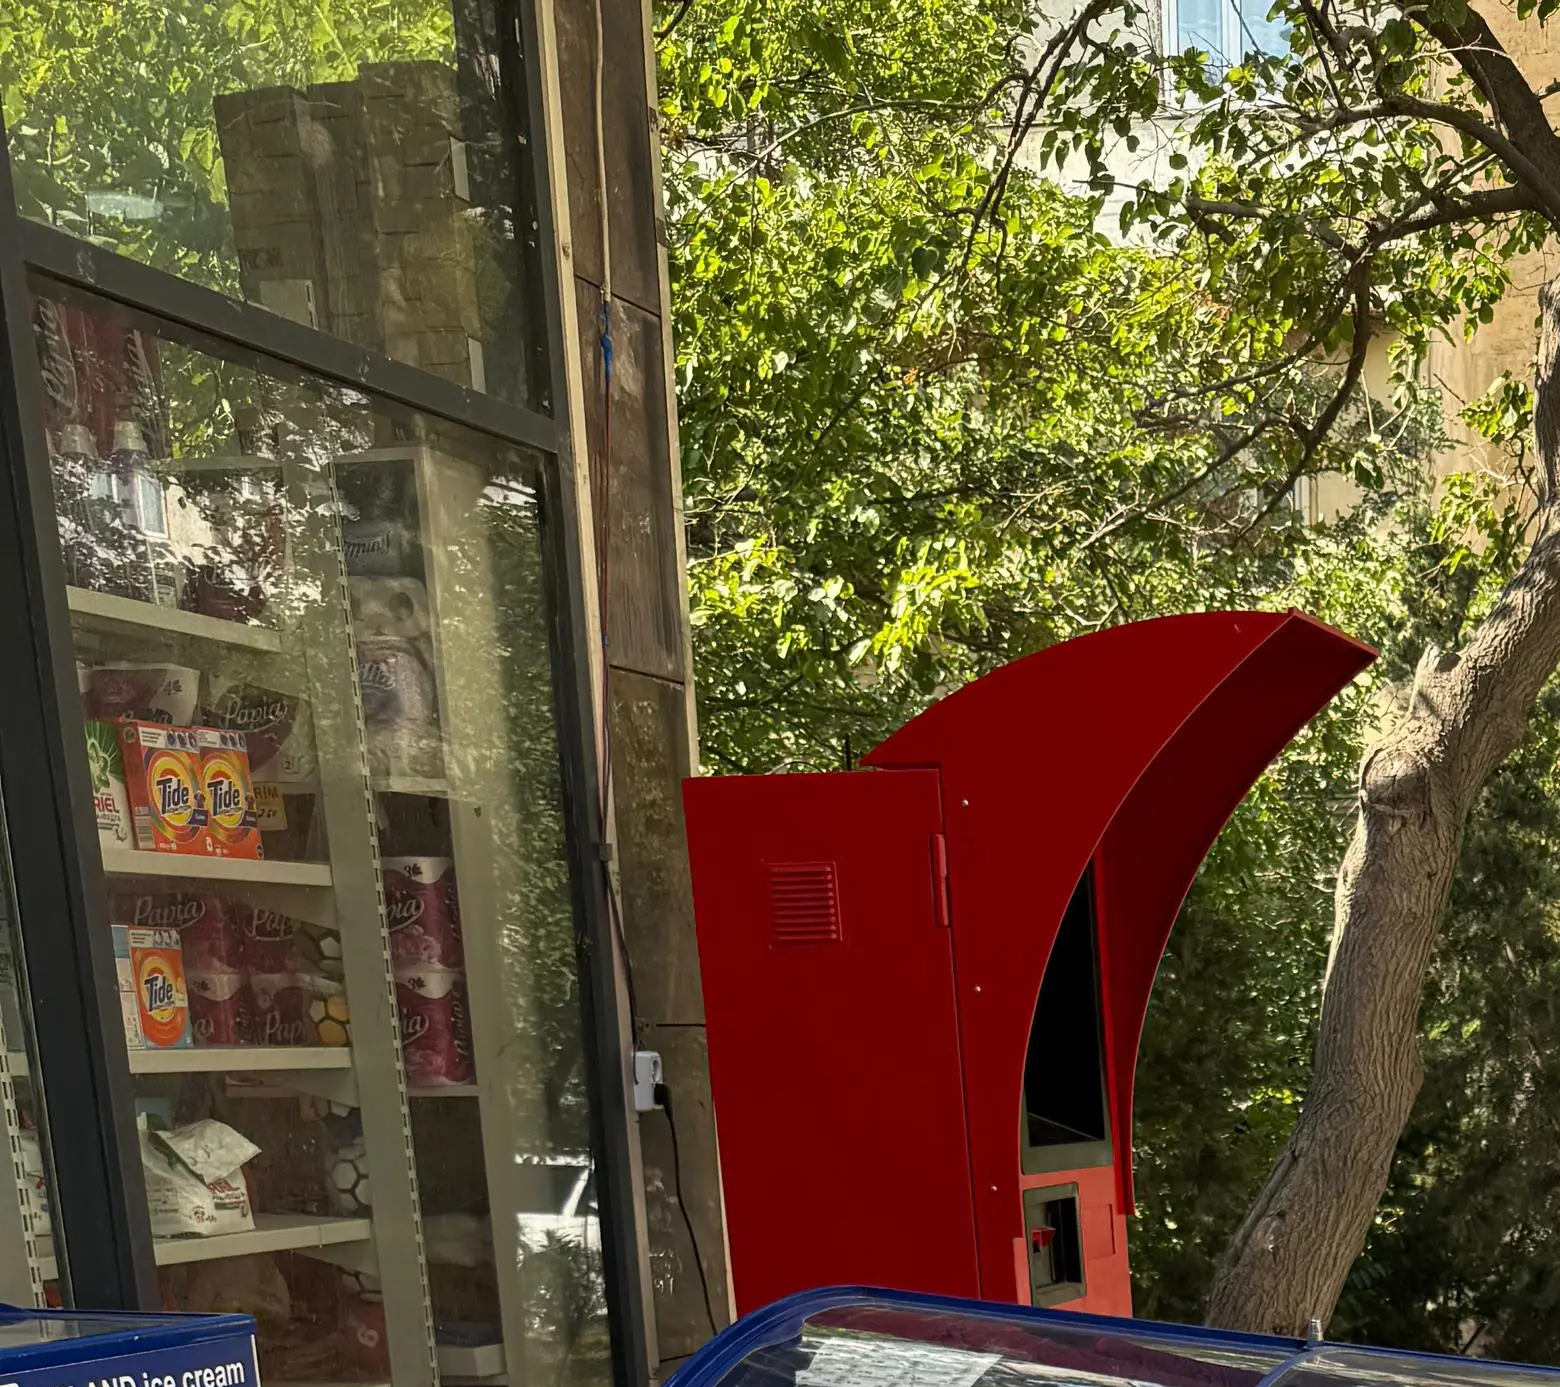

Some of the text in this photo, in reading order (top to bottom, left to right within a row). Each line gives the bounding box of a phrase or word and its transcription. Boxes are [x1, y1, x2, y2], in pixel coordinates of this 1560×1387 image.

[225, 695, 289, 731] Papia
[156, 774, 190, 816] Tide
[207, 776, 241, 817] Tide
[144, 974, 175, 1013] Tide
